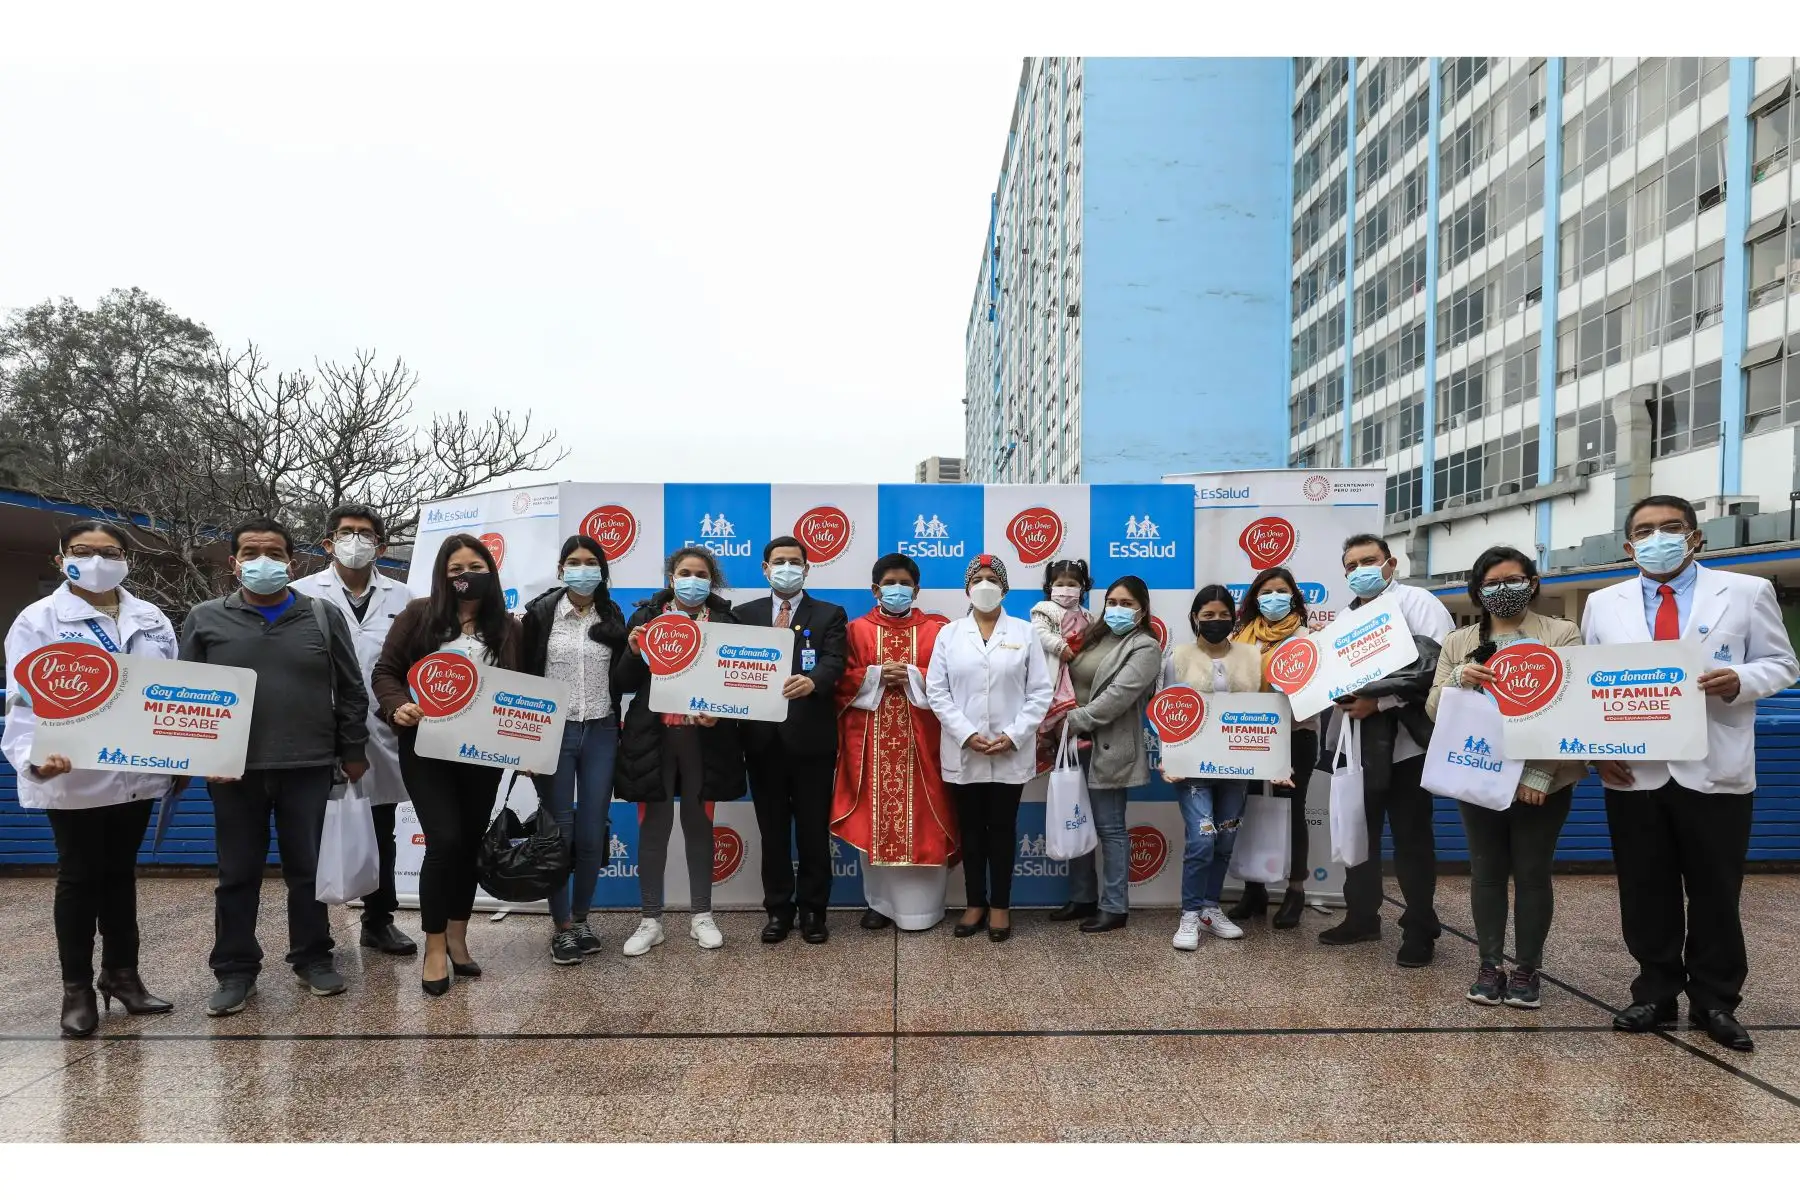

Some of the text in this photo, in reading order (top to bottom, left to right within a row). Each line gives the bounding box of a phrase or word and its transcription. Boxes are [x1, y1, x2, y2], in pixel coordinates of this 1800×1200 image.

[1201, 487, 1250, 500] EsSalud
[445, 508, 478, 521] EsSalud
[593, 518, 607, 534] Yo
[808, 520, 820, 535] Yo
[1021, 520, 1033, 536] Yo
[598, 528, 621, 542] vida
[812, 529, 835, 543] vida
[1025, 530, 1047, 544] vida
[1252, 529, 1265, 544] Yo
[898, 540, 964, 557] EsSalud
[1109, 541, 1176, 558] EsSalud
[1257, 538, 1279, 552] vida
[1308, 611, 1335, 621] ABE
[654, 628, 688, 644] Yo Dono
[1336, 615, 1386, 645] Soy donante y
[658, 640, 683, 653] vida
[1337, 647, 1349, 657] MI
[1351, 624, 1392, 652] FAMILIA
[722, 646, 737, 657] Soy
[739, 648, 769, 658] donante
[1347, 650, 1360, 661] LO
[1362, 636, 1388, 653] SABE
[41, 658, 100, 679] Yo Dono
[718, 660, 777, 672] MI FAMILIA
[1284, 660, 1305, 678] vida
[1500, 660, 1546, 681] Yo Dono
[426, 665, 465, 683] Yo Dono
[741, 672, 769, 681] SABE
[1346, 668, 1381, 692] EsSalud
[1507, 672, 1540, 691] vida
[1595, 670, 1678, 684] Soy donante y
[48, 674, 90, 692] vida
[430, 680, 458, 695] vida
[151, 685, 231, 705] Soy donante y
[1592, 686, 1682, 699] MI FAMILIA
[144, 701, 232, 719] MI FAMILIA
[498, 693, 552, 712] Soy donante y
[710, 703, 749, 714] EsSalud
[1161, 700, 1174, 715] Yo
[1603, 700, 1670, 712] LO SABE
[154, 715, 220, 730] LO SABE
[493, 706, 552, 724] MI FAMILIA
[1166, 709, 1189, 723] vida
[1224, 712, 1237, 723] Soy
[1240, 713, 1268, 722] donante
[499, 718, 543, 733] LO SABE
[1236, 726, 1277, 734] FAMILIA
[1589, 743, 1646, 754] EsSalud
[130, 755, 189, 769] EsSalud
[481, 752, 520, 765] EsSalud
[1448, 752, 1503, 772] EsSalud
[1219, 766, 1254, 775] EsSalud
[1014, 859, 1070, 876] sSalud
